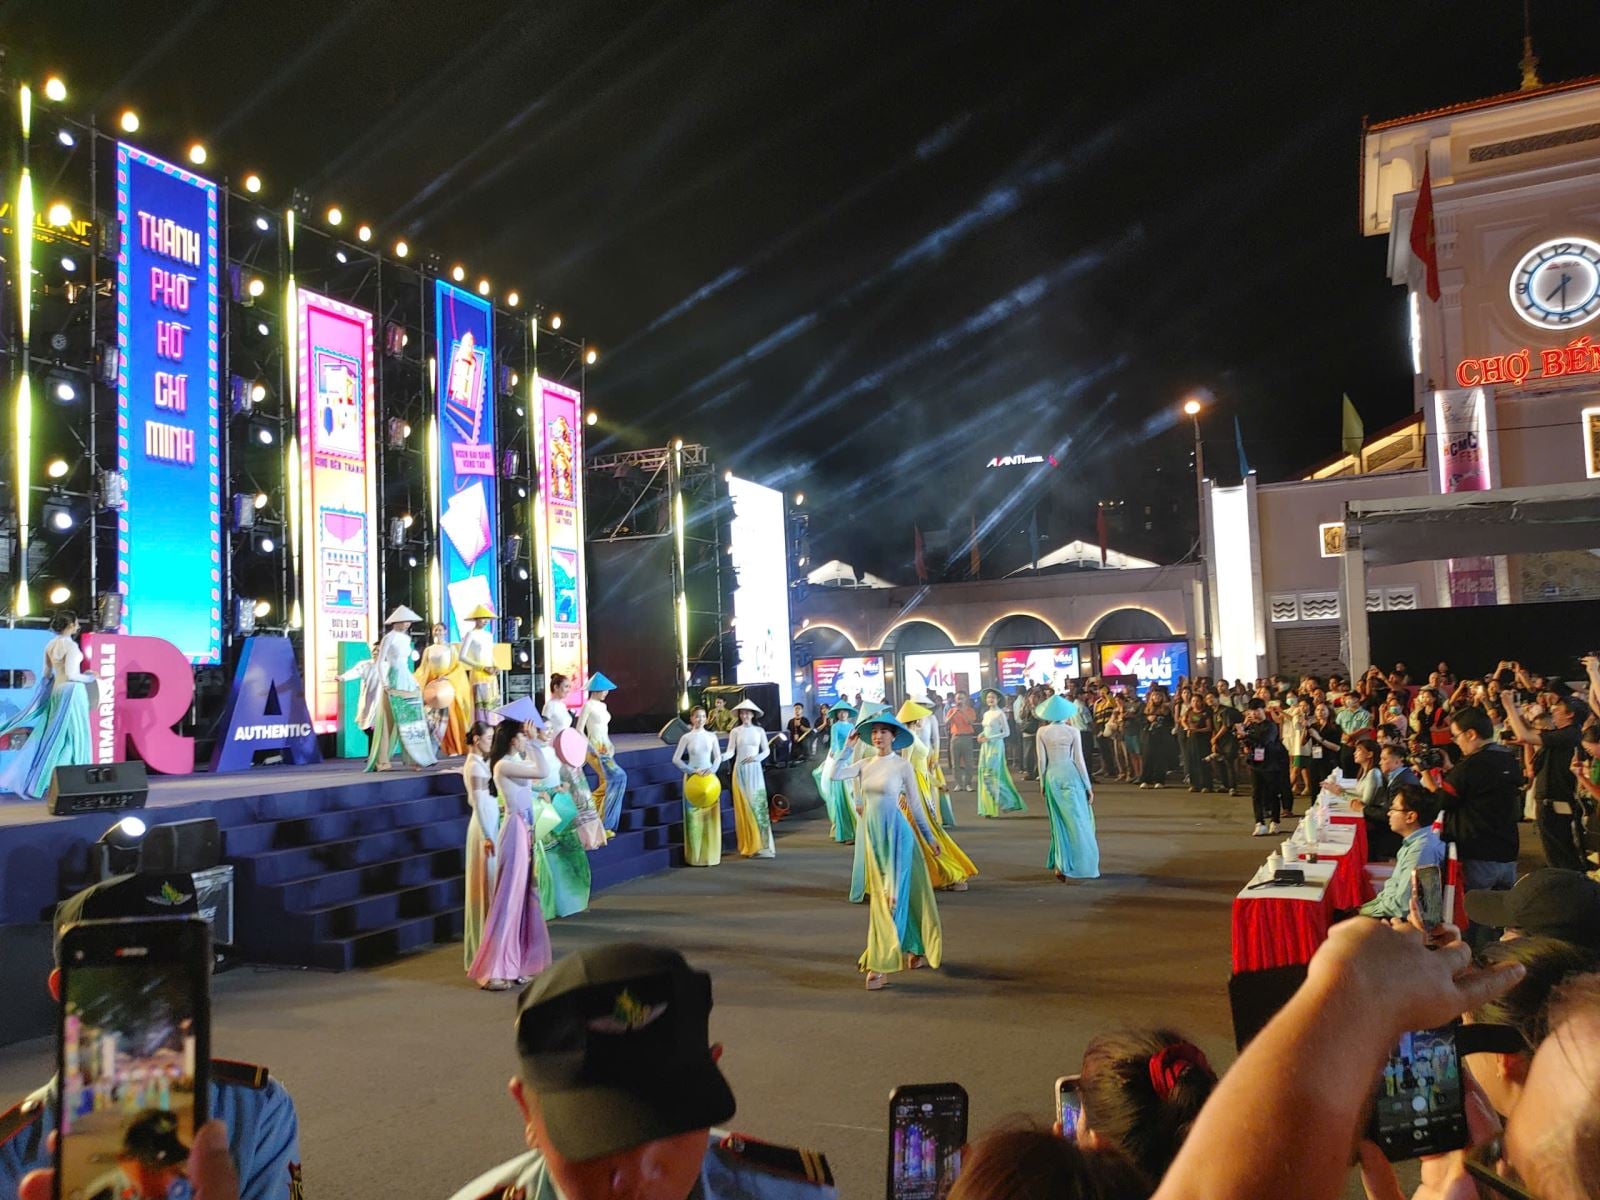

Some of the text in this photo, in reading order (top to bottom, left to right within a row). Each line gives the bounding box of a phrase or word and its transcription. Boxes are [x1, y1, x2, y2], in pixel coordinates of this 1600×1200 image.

[138, 210, 200, 266] THÀNH
[151, 266, 197, 310] PHỐ
[157, 319, 191, 358] HỒ
[1456, 349, 1530, 387] CHỢ
[155, 371, 188, 410] CHÍ
[145, 420, 195, 464] MINH
[234, 723, 311, 741] AUTHENTIC
